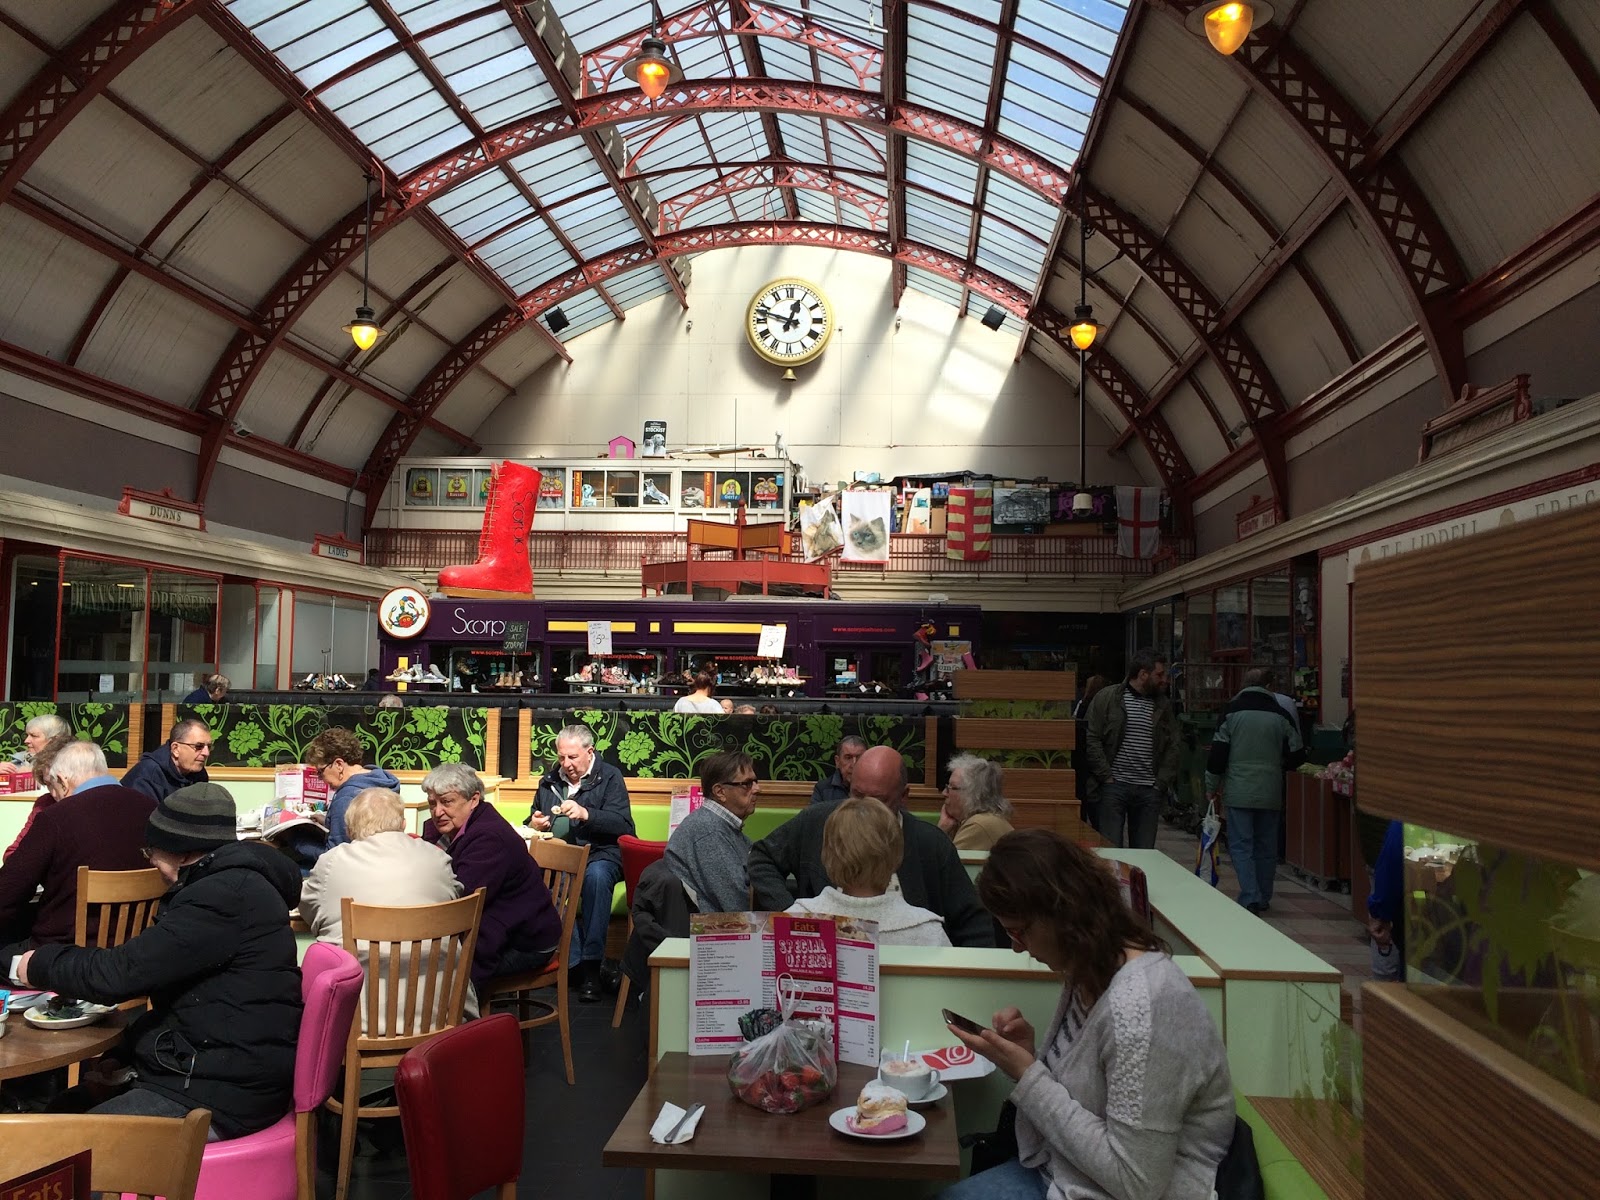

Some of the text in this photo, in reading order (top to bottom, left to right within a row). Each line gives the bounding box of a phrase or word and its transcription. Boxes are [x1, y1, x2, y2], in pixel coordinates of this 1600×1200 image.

[150, 505, 182, 522] DUNNS
[327, 545, 349, 558] LADIES
[452, 608, 507, 636] Scorp
[509, 624, 523, 633] SALE
[794, 921, 815, 932] Eats
[779, 939, 827, 954] SPECIAL
[785, 953, 832, 968] OFFERS!
[814, 985, 832, 993] £3.20
[814, 1005, 833, 1013] £2.70
